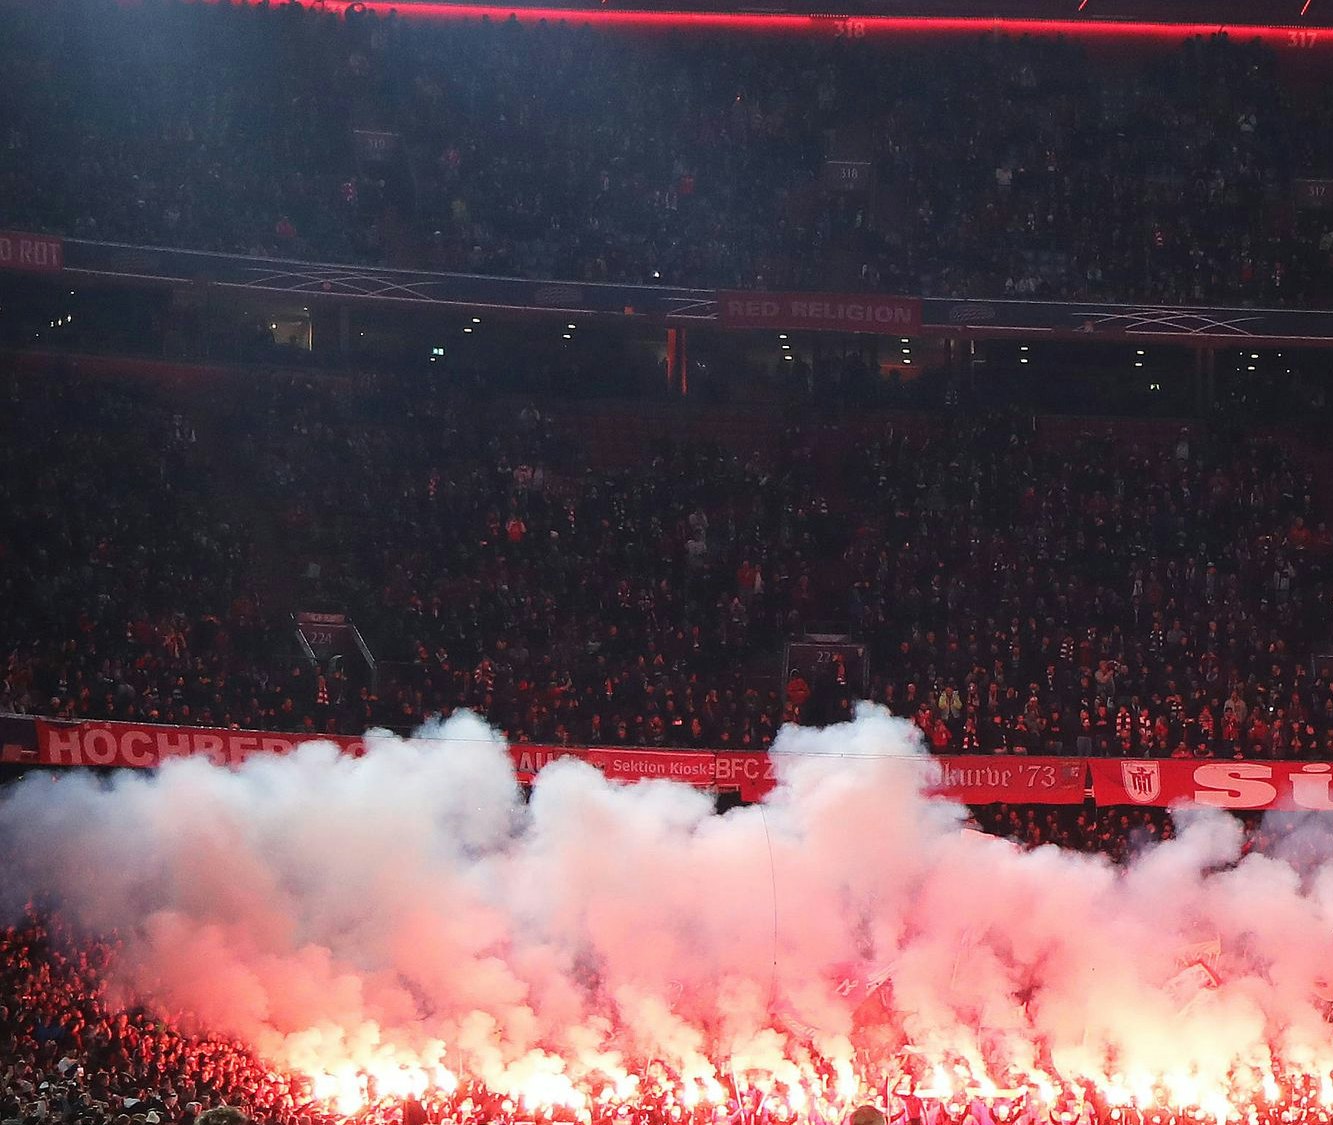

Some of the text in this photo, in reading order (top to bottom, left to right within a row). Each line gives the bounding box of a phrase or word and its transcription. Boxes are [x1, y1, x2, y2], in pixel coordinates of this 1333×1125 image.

[727, 300, 912, 323] RED RELIGION
[613, 758, 666, 775] Sektion
[715, 757, 760, 780] BFC
[1018, 765, 1056, 788] '73
